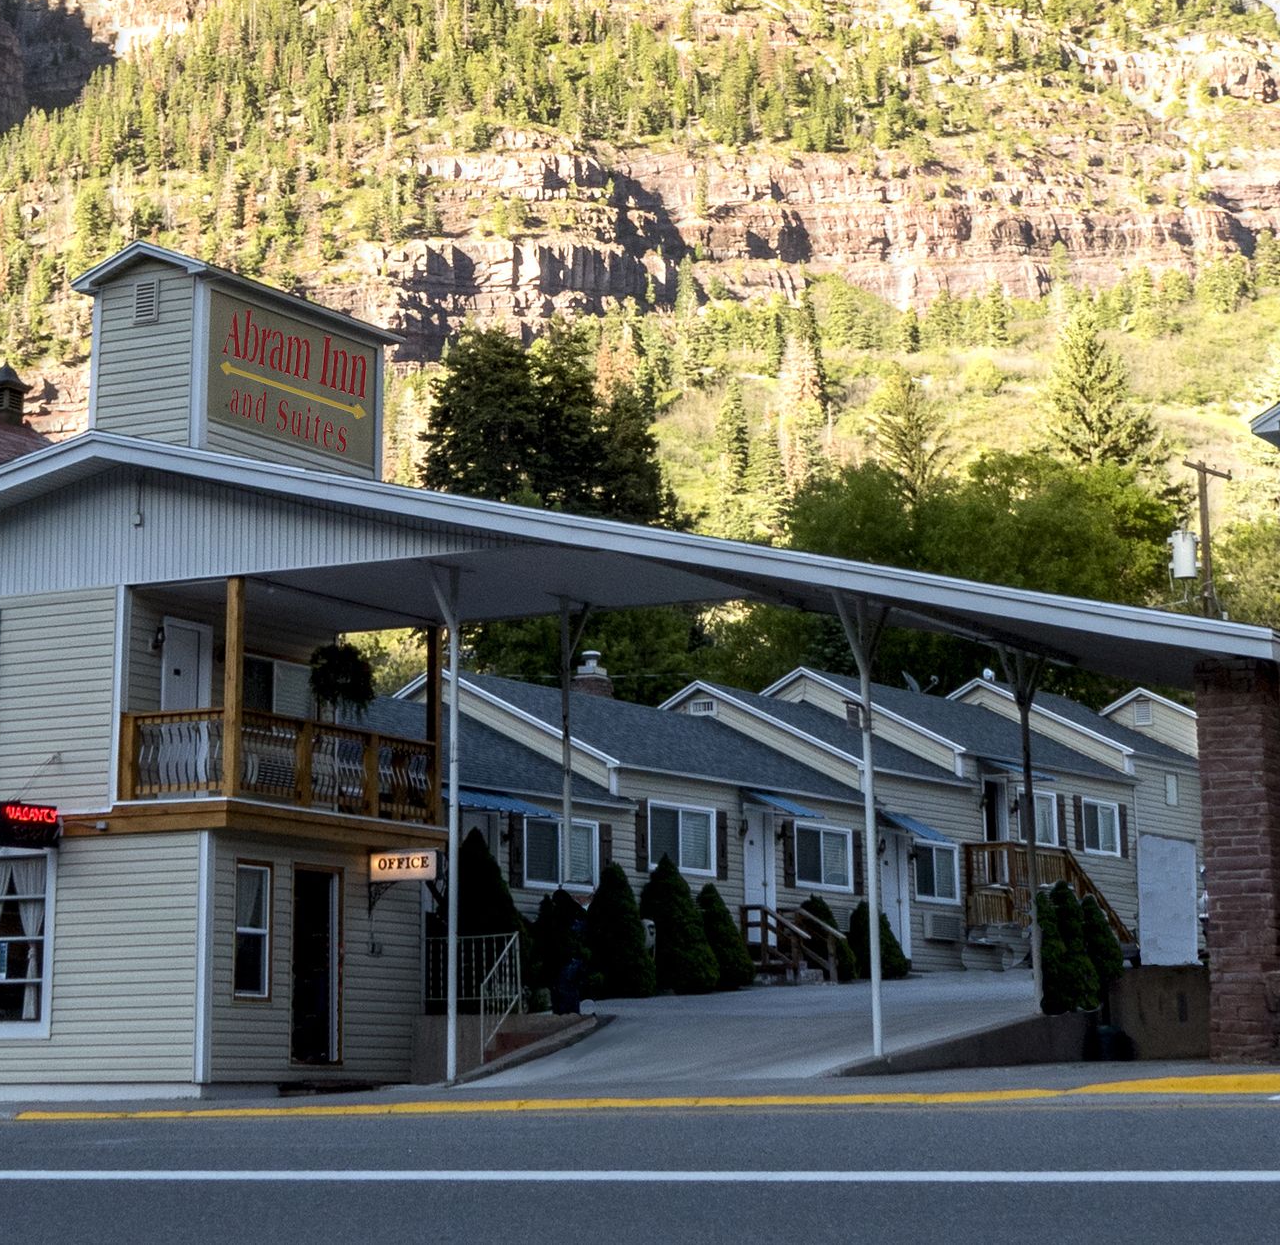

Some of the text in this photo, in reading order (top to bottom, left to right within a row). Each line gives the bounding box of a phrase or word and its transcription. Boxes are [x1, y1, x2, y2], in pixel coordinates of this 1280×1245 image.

[222, 309, 367, 400] Abram Inn
[229, 387, 348, 452] and Suites
[6, 805, 58, 823] VACANCY
[378, 856, 429, 870] OFFICE
